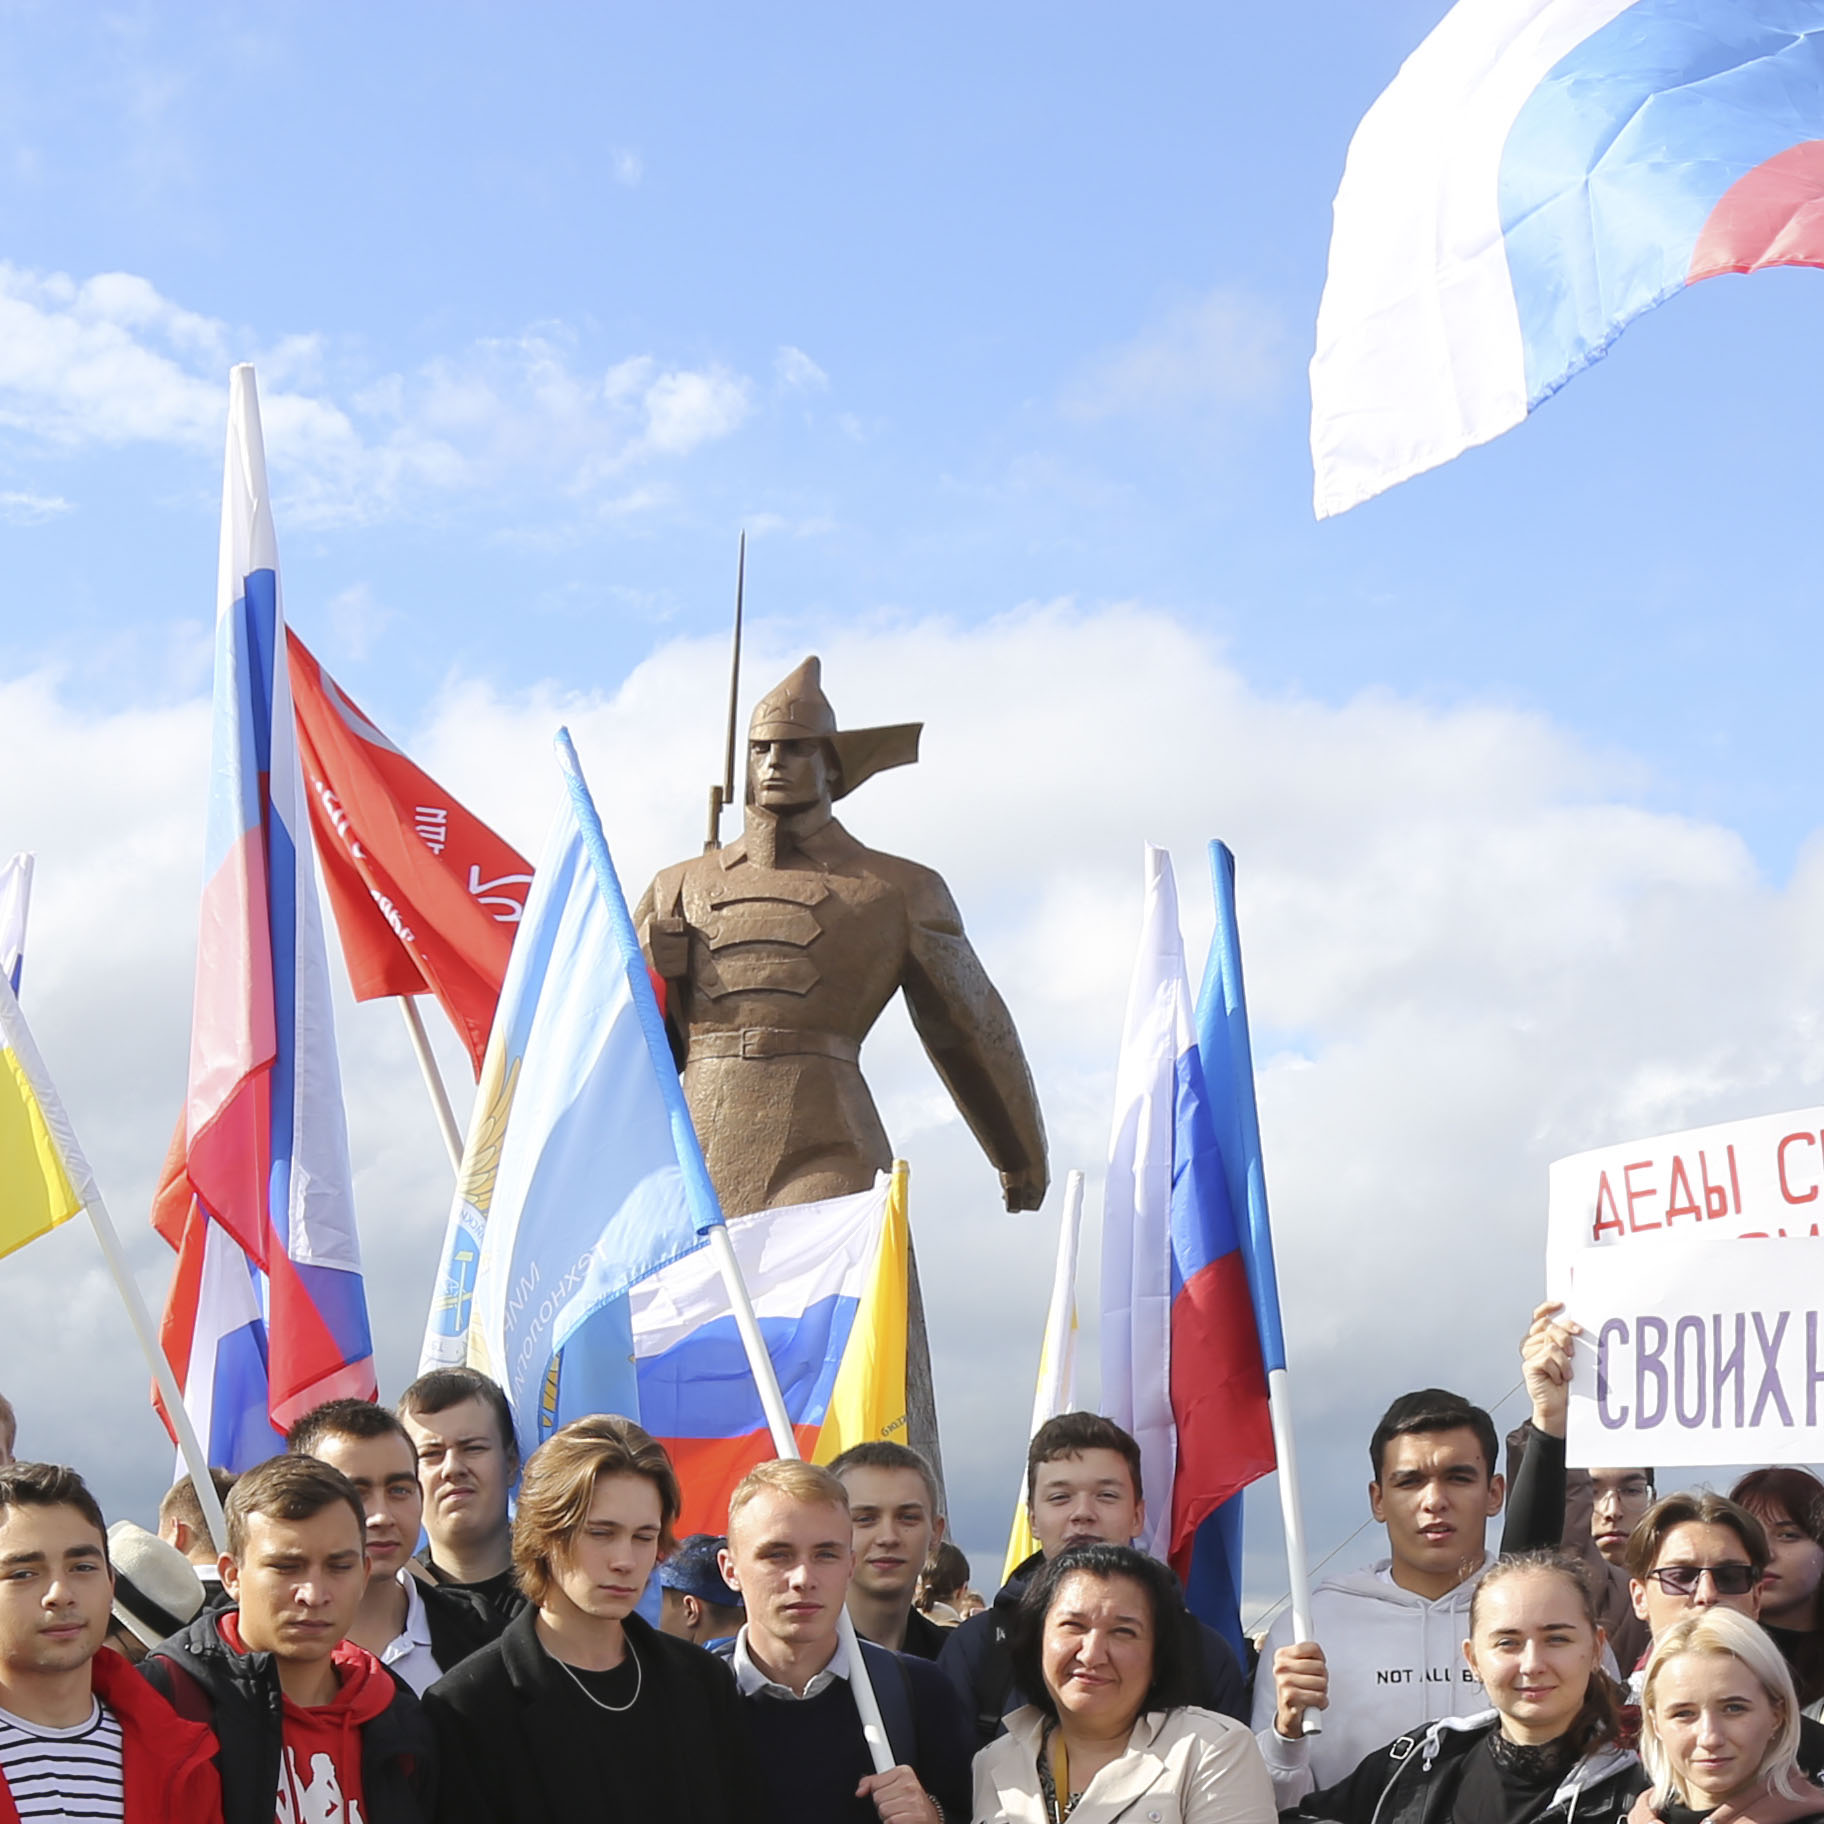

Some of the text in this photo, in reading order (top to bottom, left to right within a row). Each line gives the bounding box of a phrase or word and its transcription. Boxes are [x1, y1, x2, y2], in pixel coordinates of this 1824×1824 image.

[1591, 1143, 1742, 1242] ДЕДЫ
[1597, 1309, 1796, 1430] СВОИХ
[1376, 1668, 1414, 1685] NOT
[1419, 1667, 1452, 1683] ALL
